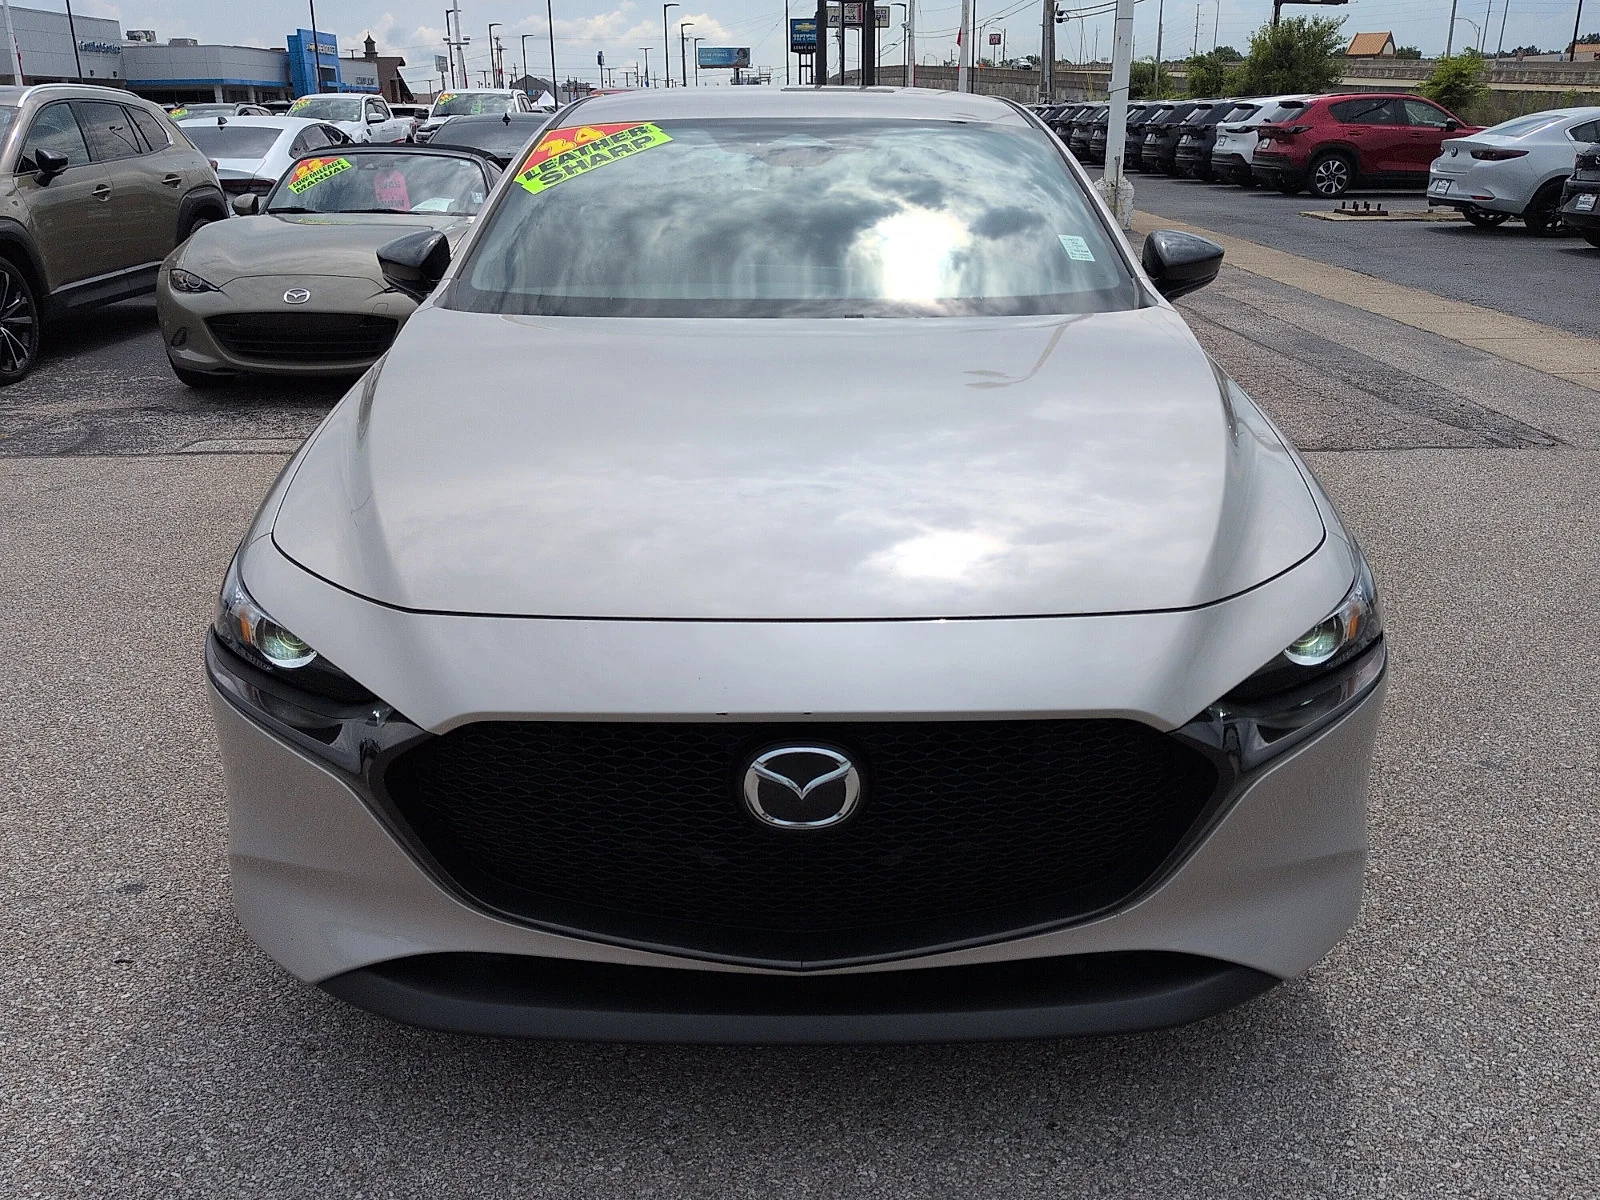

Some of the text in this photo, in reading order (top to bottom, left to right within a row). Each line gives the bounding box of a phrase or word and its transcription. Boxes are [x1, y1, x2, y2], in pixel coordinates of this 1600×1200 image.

[523, 126, 649, 181] LEATHER
[537, 127, 606, 157] 24
[292, 159, 343, 189] LOW MILEAGE
[538, 135, 656, 186] SHARP
[295, 164, 350, 193] MANUAL
